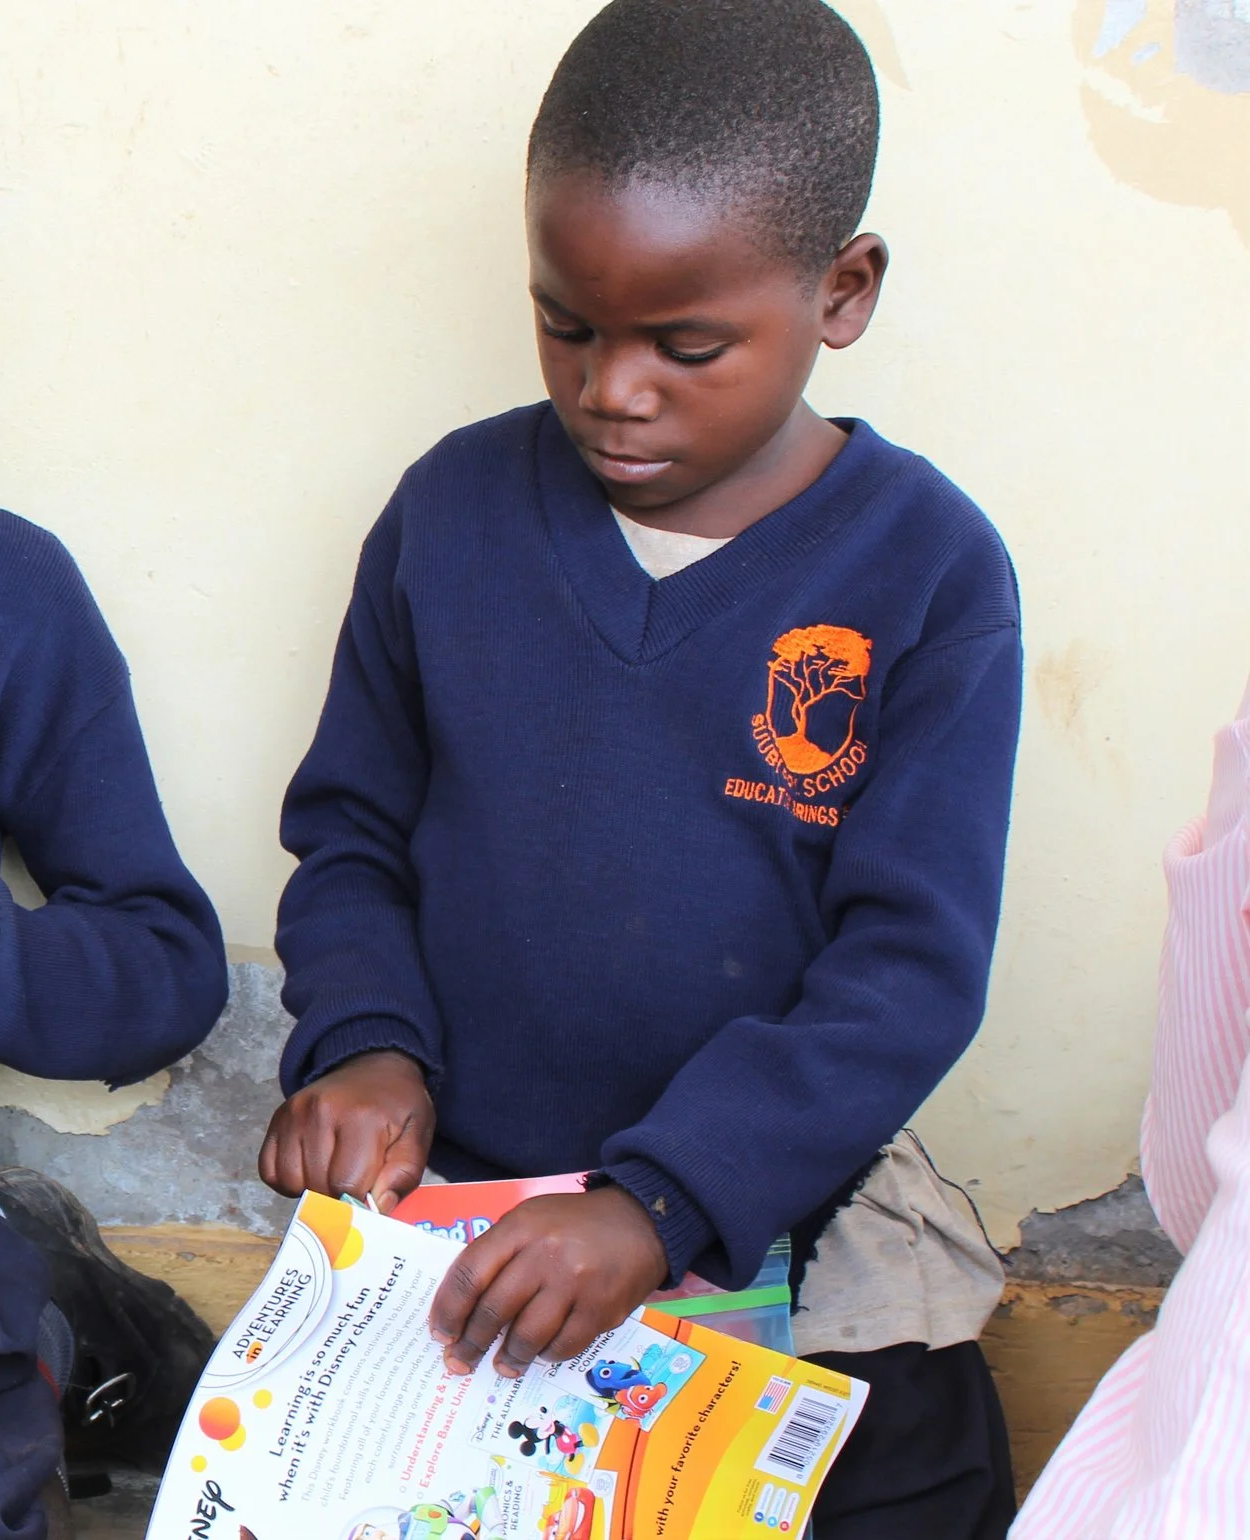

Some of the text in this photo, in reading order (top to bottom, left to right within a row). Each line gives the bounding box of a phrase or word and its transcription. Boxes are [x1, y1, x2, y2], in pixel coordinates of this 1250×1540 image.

[229, 1266, 299, 1359] ADVENTURES
[246, 1272, 312, 1361] in LEARNING
[387, 1311, 399, 1322] to
[267, 1285, 371, 1457] Learning is so much fun
[371, 1354, 387, 1371] the
[393, 1334, 418, 1365] Disney
[577, 1330, 615, 1374] COUNTING
[276, 1254, 408, 1502] when it's with Disney characters!
[320, 1398, 346, 1445] workbook
[400, 1395, 444, 1481] Understanding
[435, 1383, 447, 1393] &
[419, 1441, 444, 1488] Explore
[437, 1407, 458, 1439] Basic
[451, 1375, 472, 1407] Units
[491, 1420, 504, 1440] THE
[307, 1445, 329, 1480] Disney
[655, 1360, 742, 1536] with your favorite characters!
[300, 1480, 315, 1502] This
[510, 1485, 523, 1530] READING
